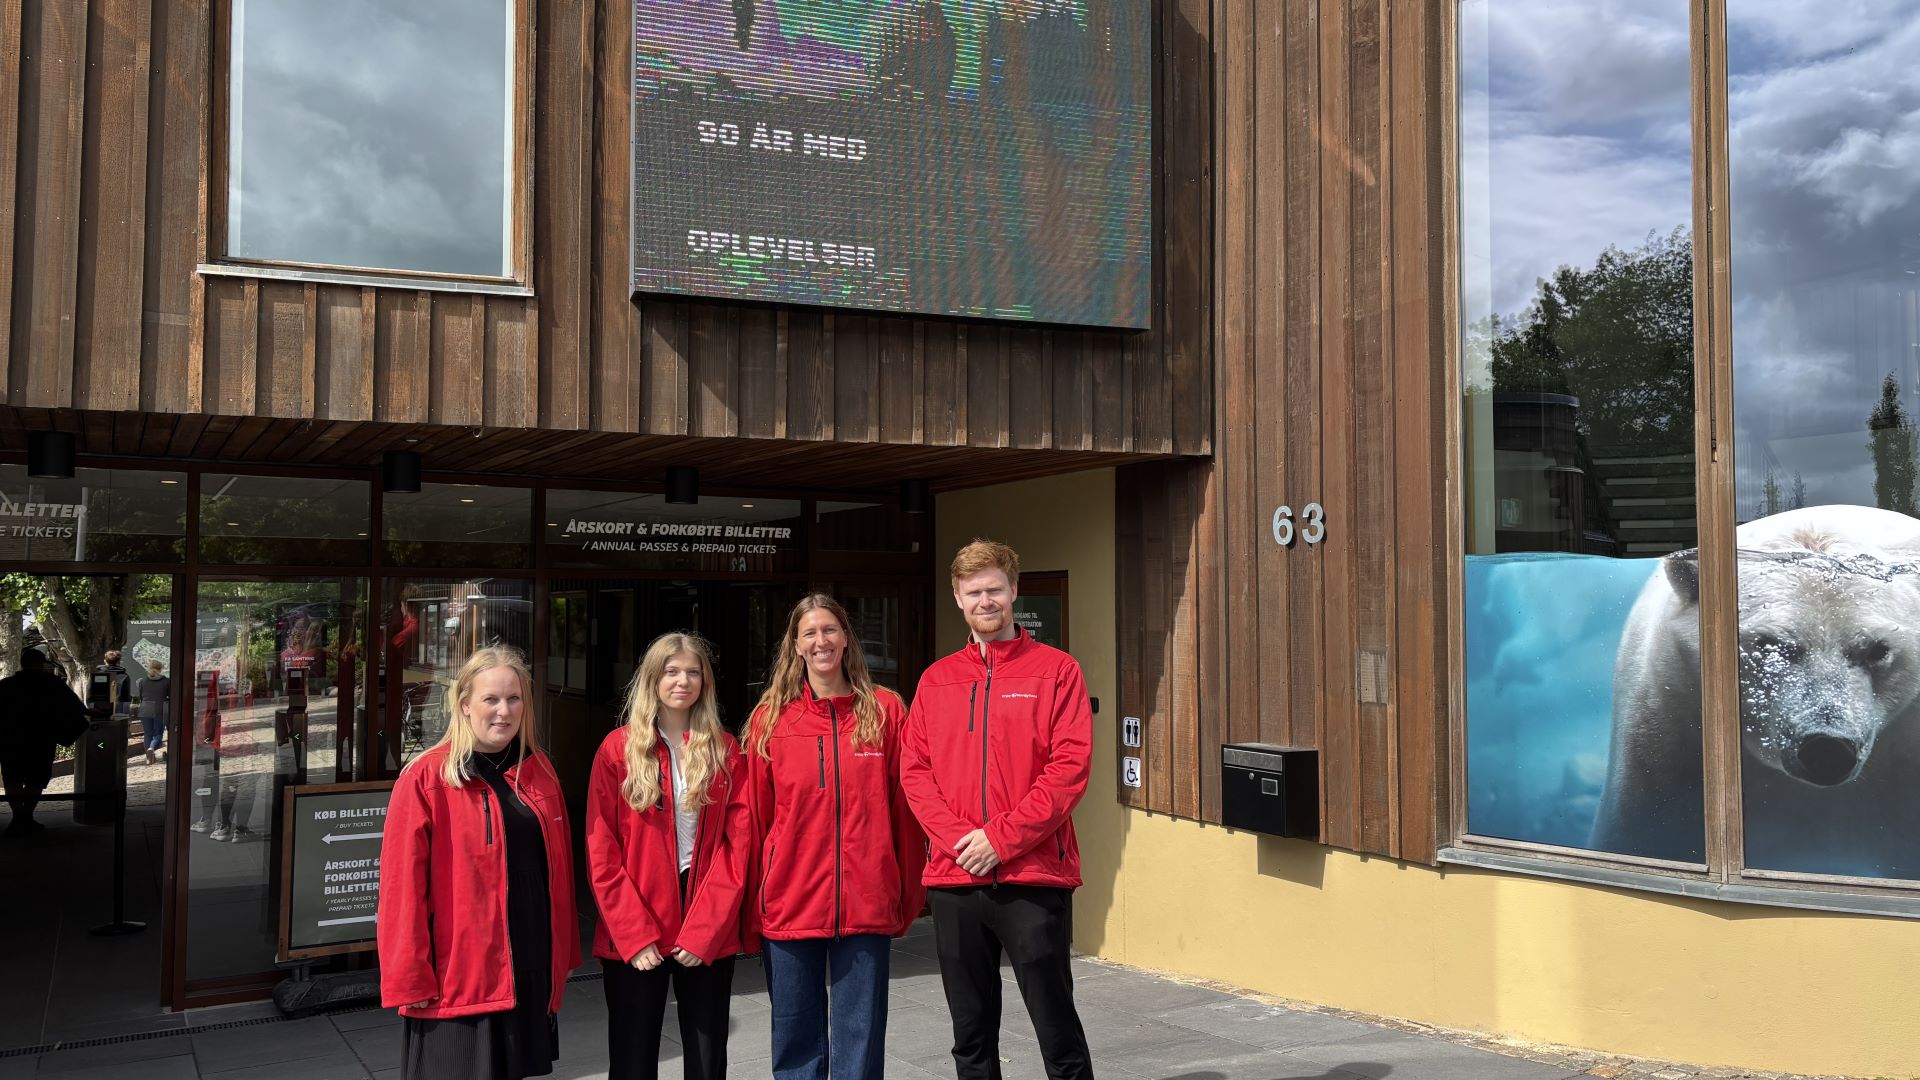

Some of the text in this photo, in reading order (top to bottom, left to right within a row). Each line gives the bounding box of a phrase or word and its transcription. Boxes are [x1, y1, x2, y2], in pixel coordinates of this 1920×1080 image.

[698, 120, 740, 145] 90
[803, 133, 867, 160] MED
[687, 229, 875, 267] OPLEVELSER
[0, 502, 88, 518] LLETTER
[565, 518, 791, 539] ÅRSKORT & FORKØBTE BILLETTER
[1272, 502, 1325, 546] 63
[11, 525, 73, 538] TICKETS
[590, 540, 636, 551] ANNUAL
[639, 541, 679, 552] PASSES
[681, 542, 690, 552] &
[692, 542, 736, 553] PREPAID
[738, 543, 777, 554] TICKETS
[314, 807, 388, 820] KØB BILLETTE
[324, 858, 372, 871] ÅRSKORT
[324, 870, 381, 883] FORKØBTE
[324, 882, 380, 895] BILLETTER
[330, 897, 351, 905] YEARLY
